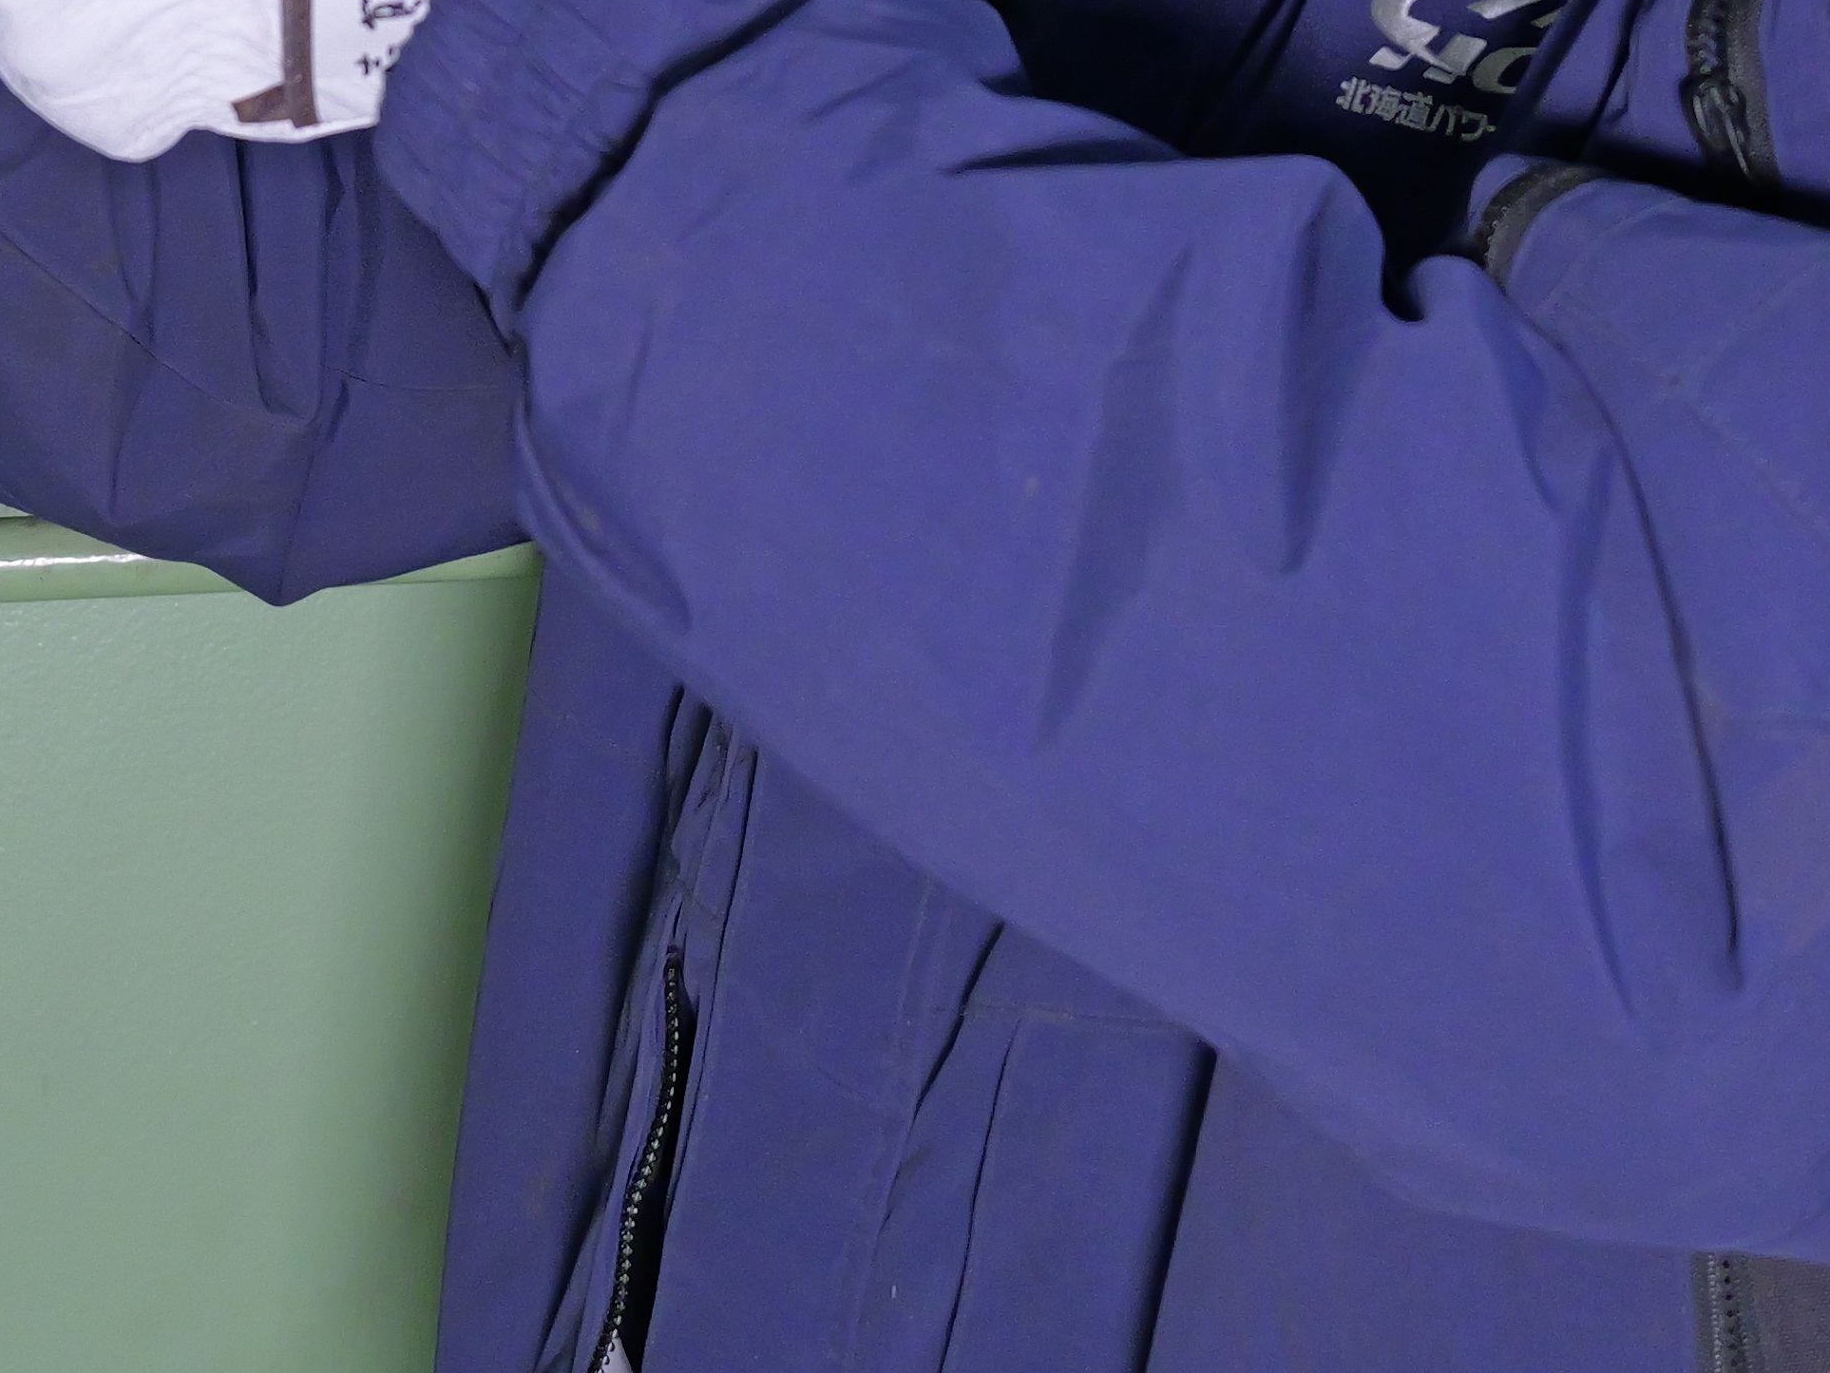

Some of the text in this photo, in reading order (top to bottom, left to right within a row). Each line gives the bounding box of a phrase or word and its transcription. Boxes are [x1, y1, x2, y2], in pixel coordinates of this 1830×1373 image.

[1335, 76, 1497, 142] 北海道パワ
